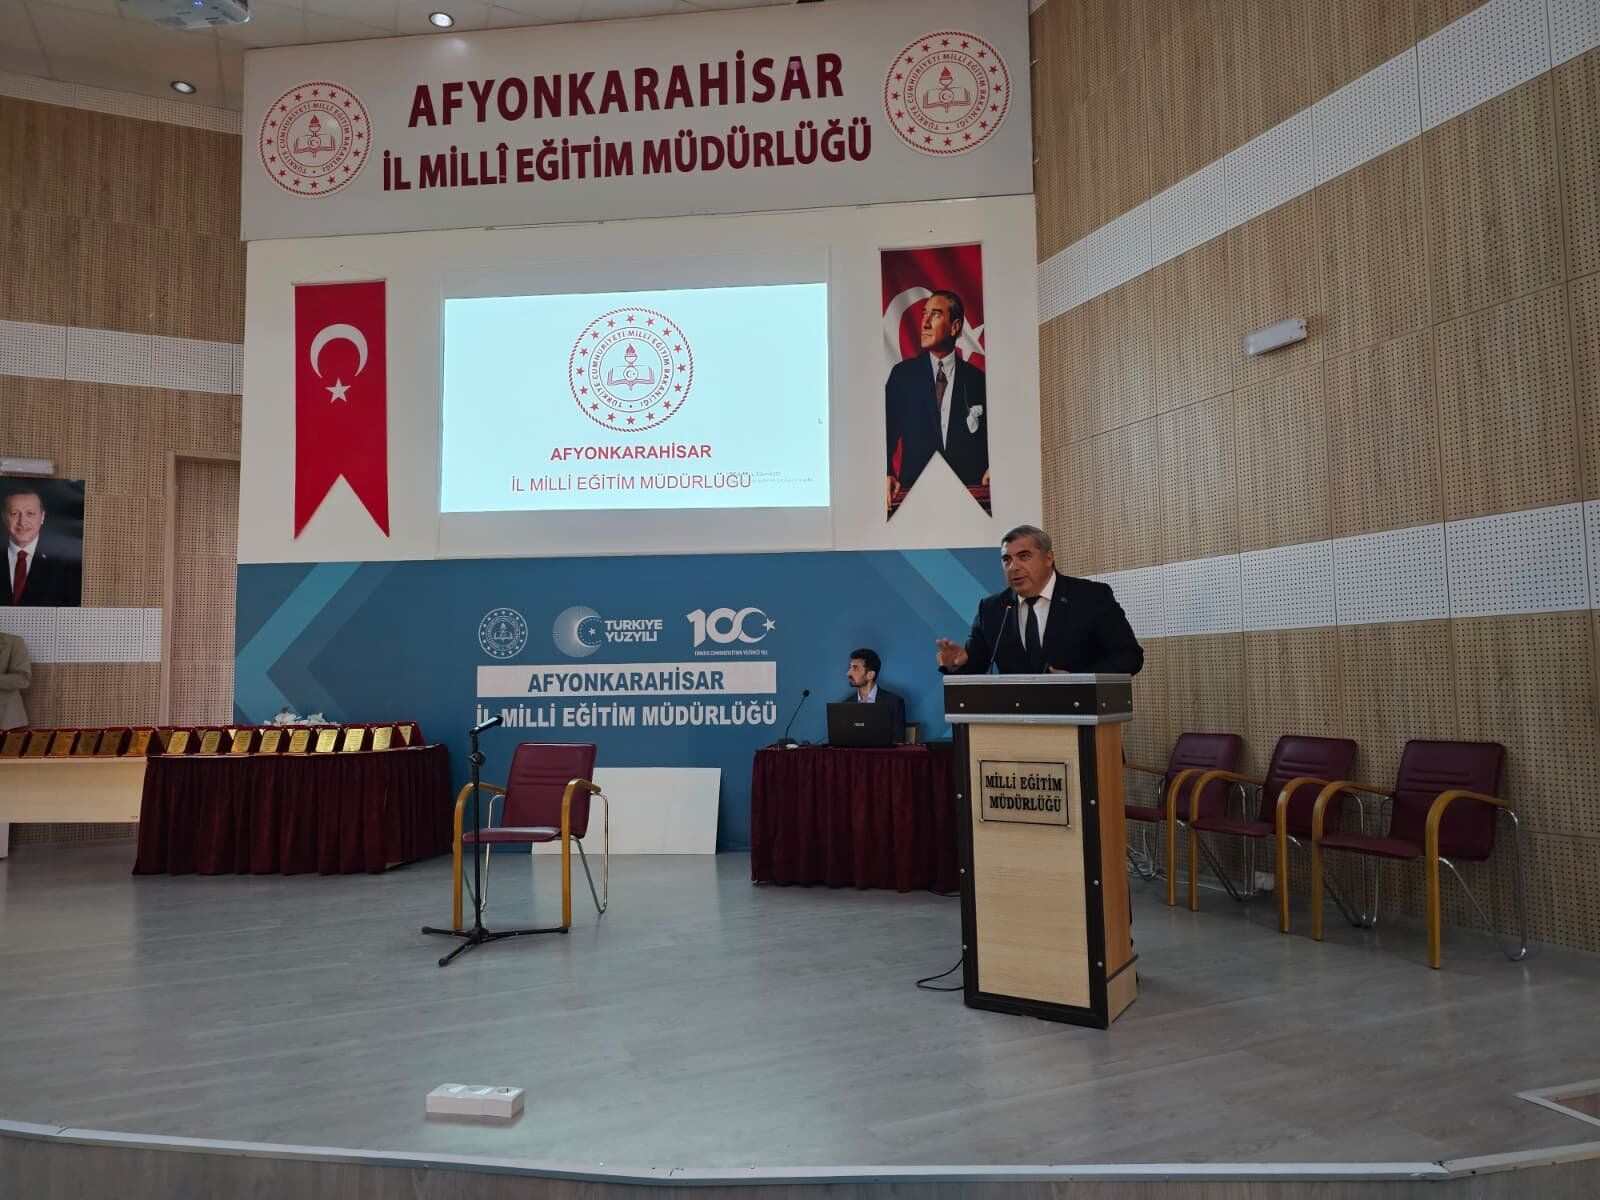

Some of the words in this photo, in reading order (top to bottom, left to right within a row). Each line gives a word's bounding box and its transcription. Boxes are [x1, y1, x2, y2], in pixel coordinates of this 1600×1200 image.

[408, 50, 843, 127] AFYONKARAHİSAR
[383, 150, 411, 191] İL
[517, 135, 633, 183] EĞİTİM
[642, 116, 871, 175] MÜDÜRLÜĞÜ
[550, 442, 712, 461] AFYONKARAHİSAR
[512, 475, 525, 492] İL
[530, 474, 572, 491] MİLLİ
[577, 472, 635, 490] EĞİTİM
[640, 472, 752, 489] MÜDÜRLÜĞÜ
[686, 607, 768, 648] 100
[528, 667, 724, 692] AFYONKARAHİSAR
[501, 703, 555, 727] MİLLİ
[563, 702, 635, 727] EĞİTİM
[642, 701, 777, 726] MÜDÜRLÜĞÜ
[985, 772, 1016, 789] MİLLİ
[1020, 773, 1062, 791] EĞİTİM
[989, 793, 1062, 812] MÜDÜRLÜĞÜ
